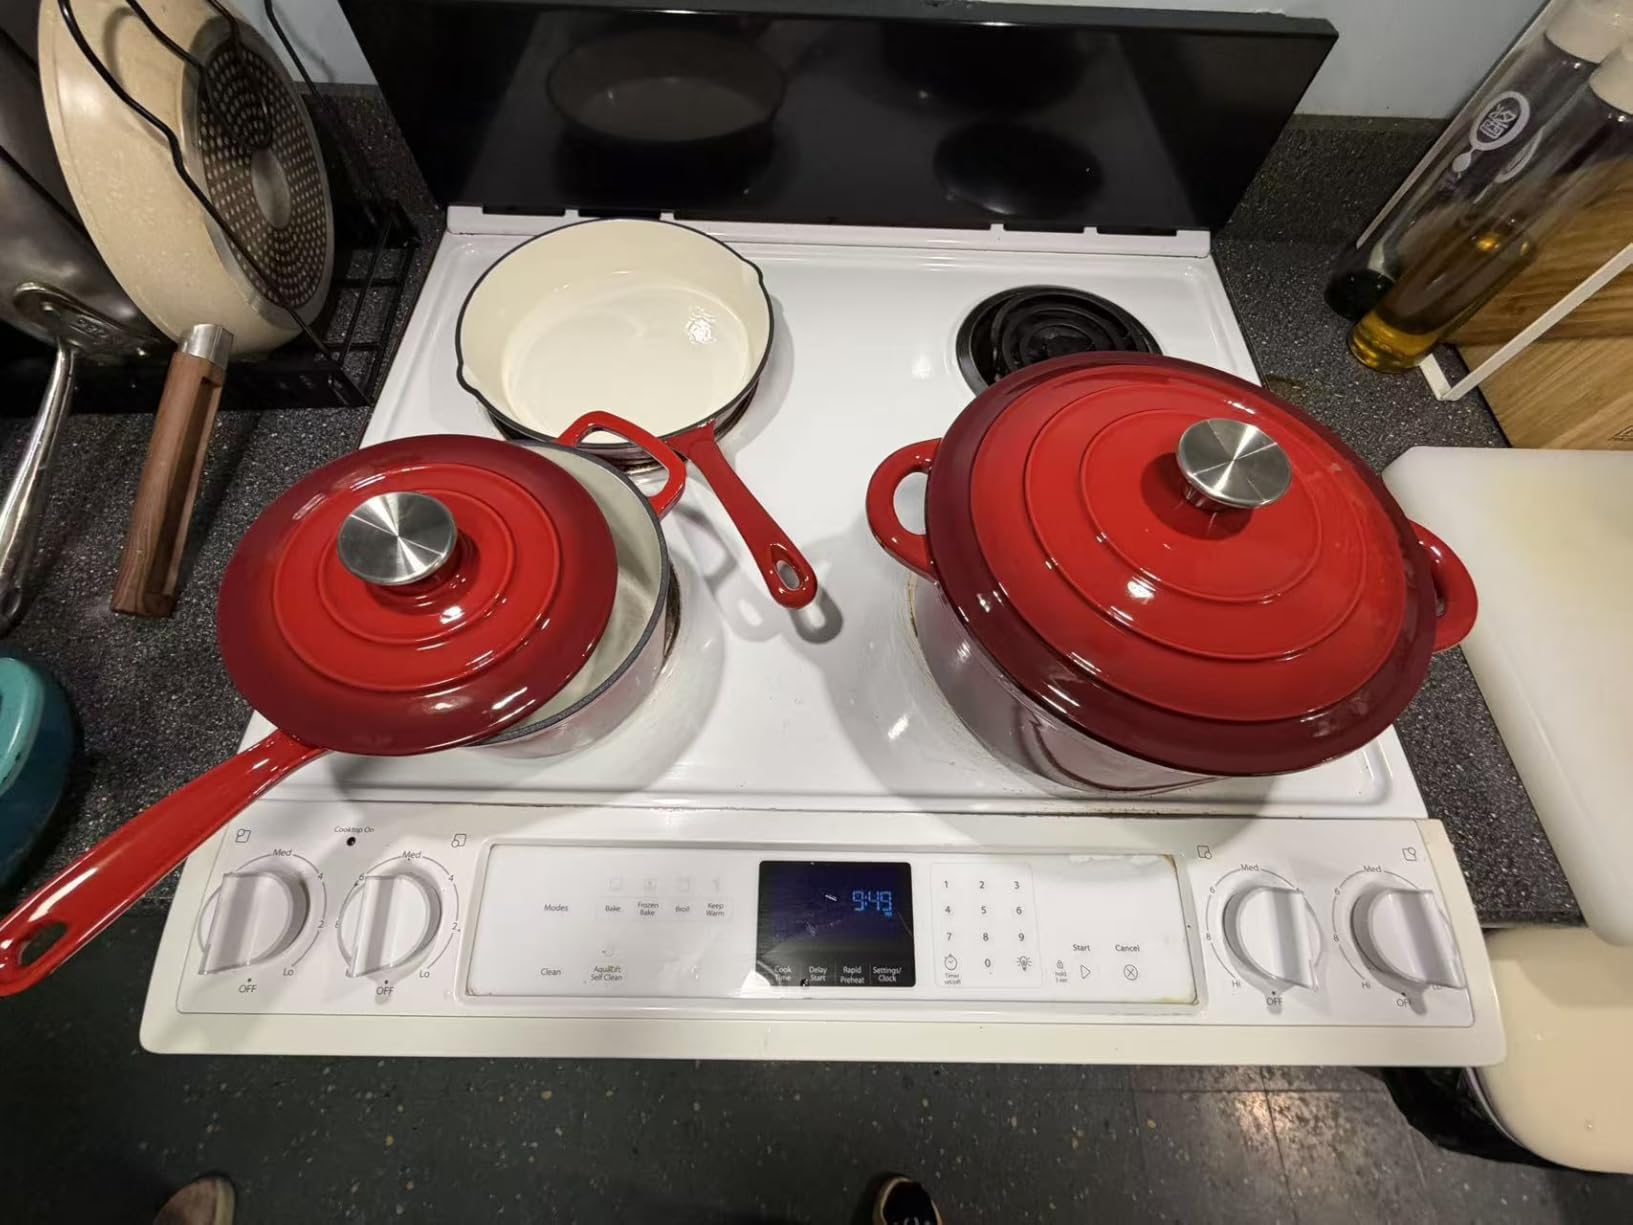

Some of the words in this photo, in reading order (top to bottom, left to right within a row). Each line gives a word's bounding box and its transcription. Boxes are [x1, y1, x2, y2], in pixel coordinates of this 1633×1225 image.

[334, 826, 363, 834] Cooktop
[272, 848, 293, 857] Med
[402, 850, 422, 859] Med
[1240, 864, 1259, 872] Med
[1363, 865, 1382, 873] Med
[317, 872, 324, 880] 4
[358, 872, 365, 881] 6
[448, 874, 455, 882] 4
[944, 880, 949, 889] 1
[979, 880, 985, 890] 2
[1013, 880, 1020, 890] 3
[1209, 886, 1216, 894] 6
[852, 890, 893, 912] 9:49
[544, 904, 569, 912] Modes
[605, 905, 622, 913] Bake
[637, 902, 660, 910] Frozen
[675, 905, 690, 913] Broil
[707, 902, 724, 911] Keep
[944, 905, 951, 914] 4
[980, 905, 987, 914] 5
[1015, 906, 1023, 915] 6
[639, 909, 655, 917] Bake
[706, 909, 725, 917] Warm
[317, 920, 325, 929] 2
[451, 922, 458, 931] 2
[946, 932, 952, 941] 7
[982, 932, 989, 942] 8
[1018, 932, 1025, 942] 9
[1205, 932, 1212, 940] 8
[1072, 943, 1091, 952] Start
[1115, 943, 1141, 953] Cancel
[984, 958, 991, 968] 0
[283, 967, 294, 976] Lo
[419, 969, 430, 978] Lo
[540, 967, 562, 976] Clean
[774, 966, 792, 974] Cook
[808, 966, 828, 975] Delay
[843, 966, 862, 975] Rapid
[590, 974, 603, 982] Self
[603, 974, 623, 982] Clean
[810, 974, 826, 982] Start
[840, 977, 865, 985] Preheat
[878, 975, 897, 983] Clock
[238, 984, 257, 993] OFF
[1232, 980, 1240, 988] Hi
[1361, 981, 1371, 989] Hi
[376, 986, 394, 995] OFF
[1266, 997, 1283, 1006] OFF
